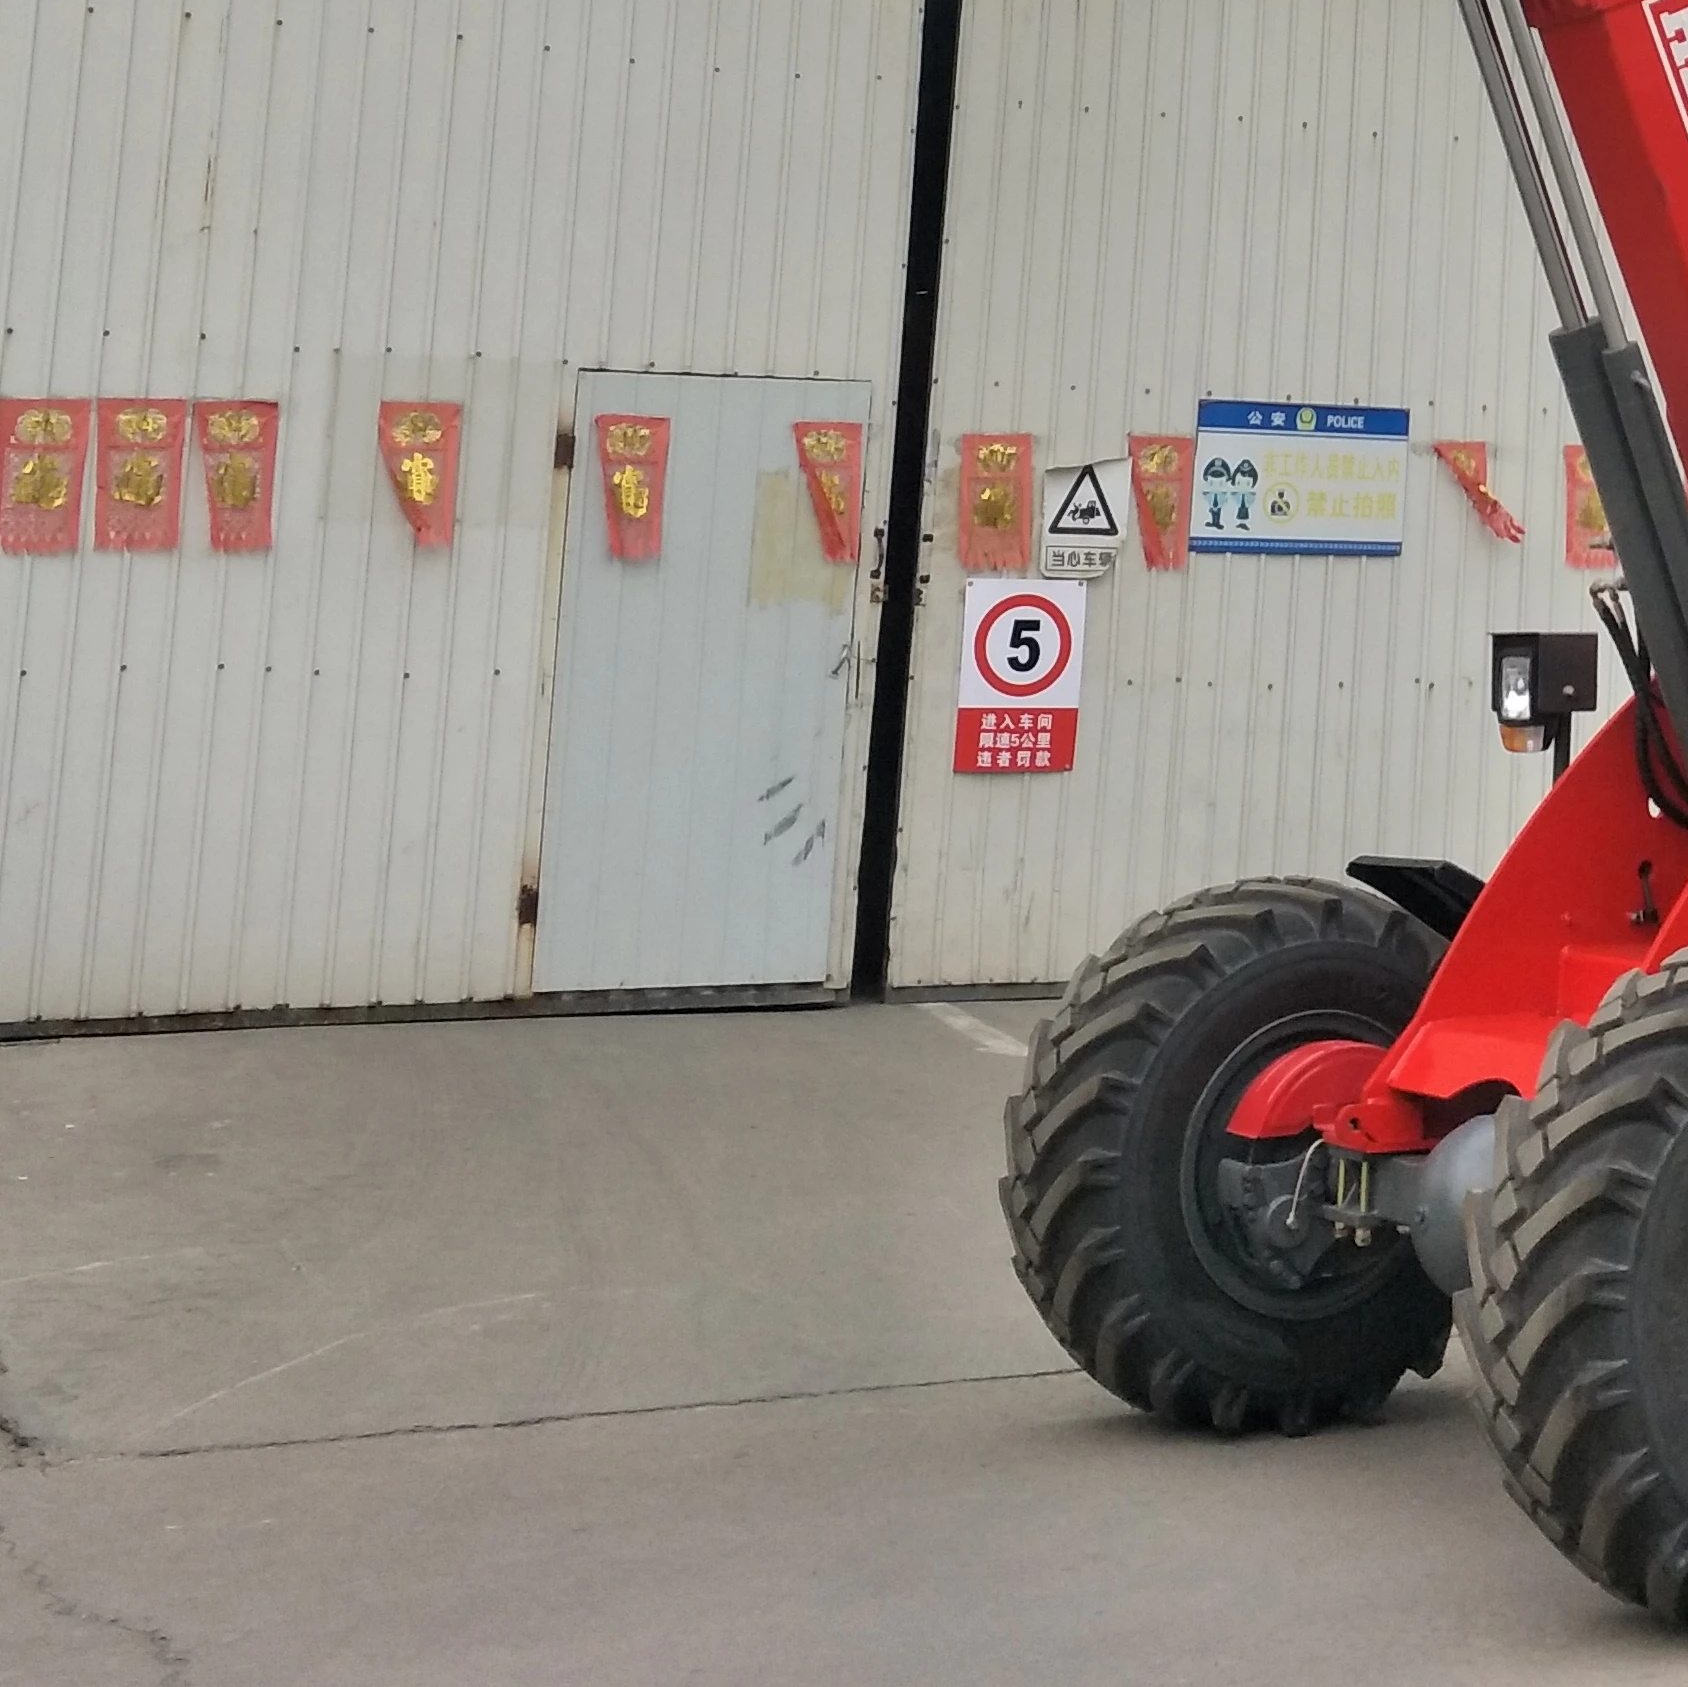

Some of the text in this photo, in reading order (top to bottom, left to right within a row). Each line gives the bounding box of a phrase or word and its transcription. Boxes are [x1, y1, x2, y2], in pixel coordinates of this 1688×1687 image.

[1247, 410, 1365, 429] 公安 POLICE
[1306, 489, 1397, 520] 禁止拍照
[1006, 619, 1041, 672] 5
[980, 713, 1053, 730] 进入车间
[978, 732, 1052, 749] 限速5公里
[976, 750, 1052, 767] 违者罚款
